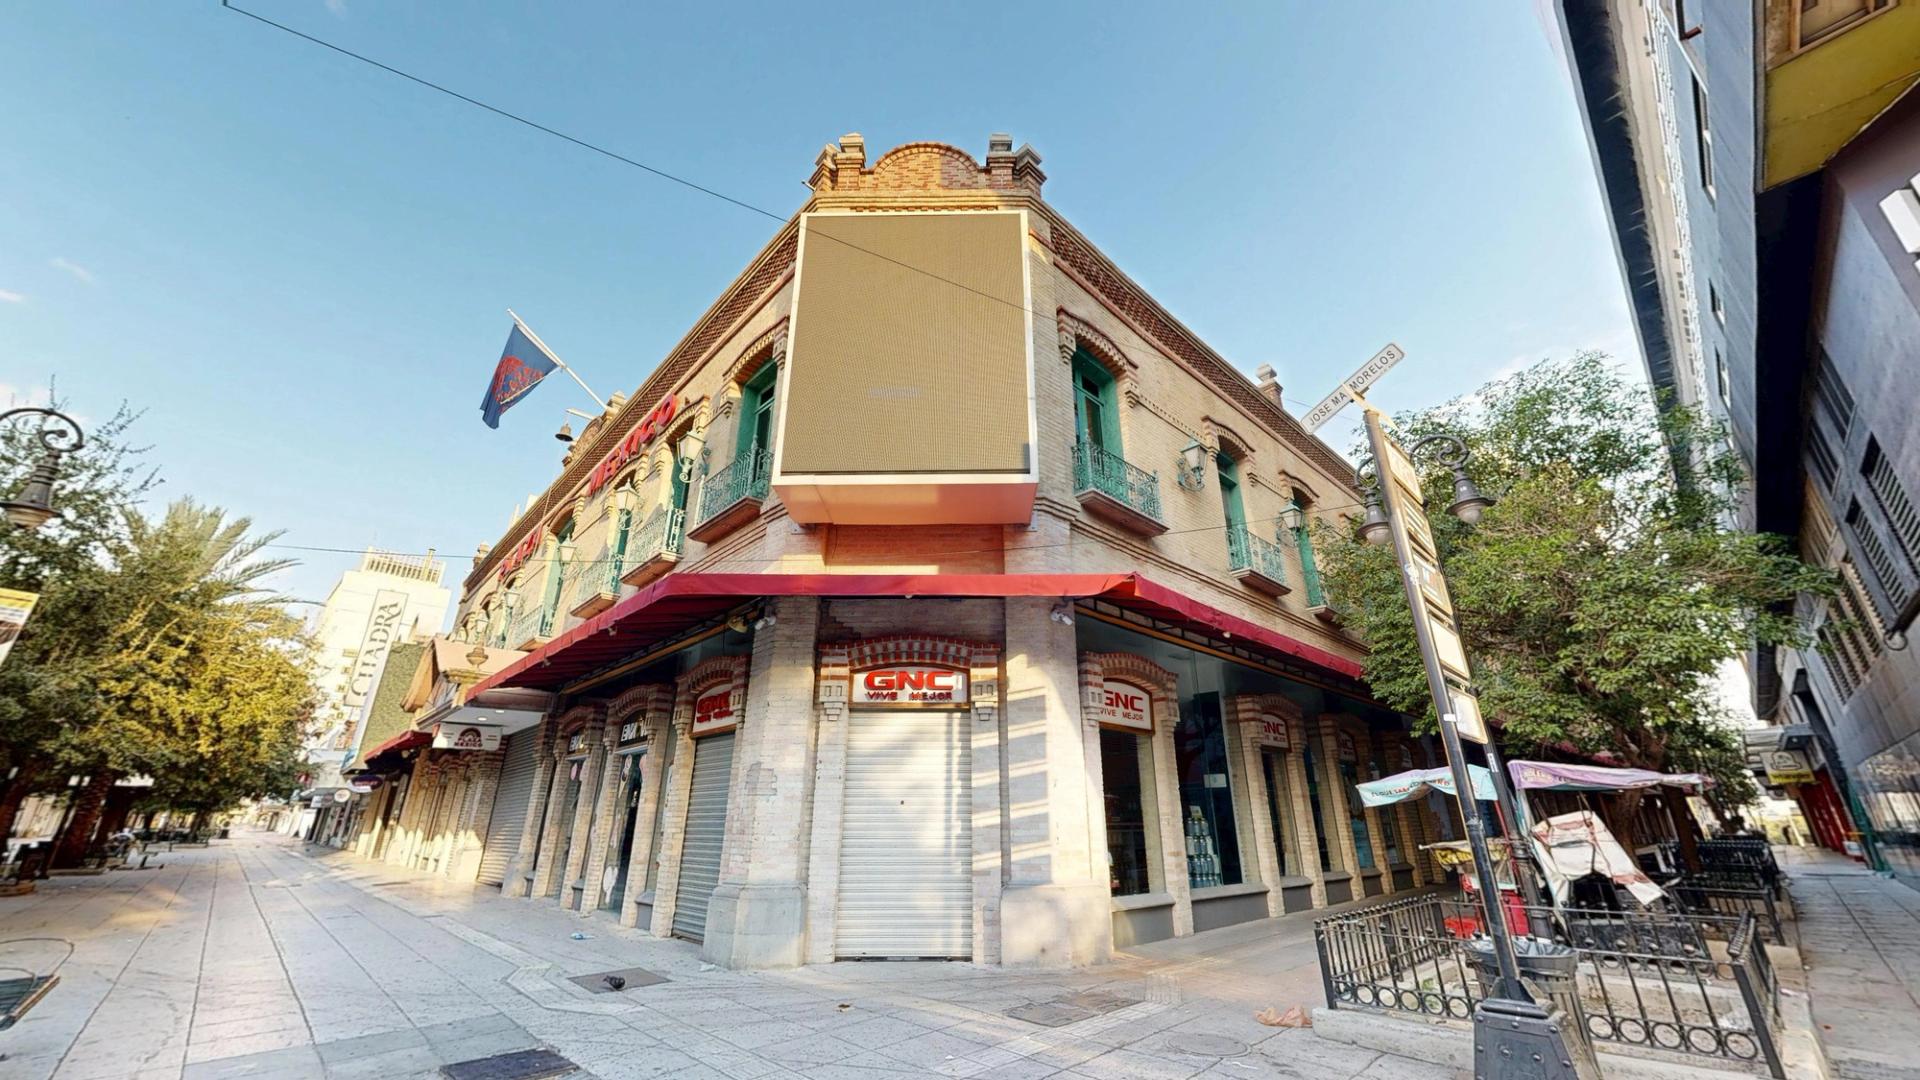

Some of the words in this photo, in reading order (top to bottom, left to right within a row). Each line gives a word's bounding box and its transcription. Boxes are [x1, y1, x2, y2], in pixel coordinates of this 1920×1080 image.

[1309, 403, 1332, 426] JOSE
[1331, 391, 1347, 406] MA
[1348, 350, 1396, 390] MORELOS
[864, 671, 955, 690] GNC
[865, 692, 898, 700] VIVE
[909, 692, 953, 701] MEJOR
